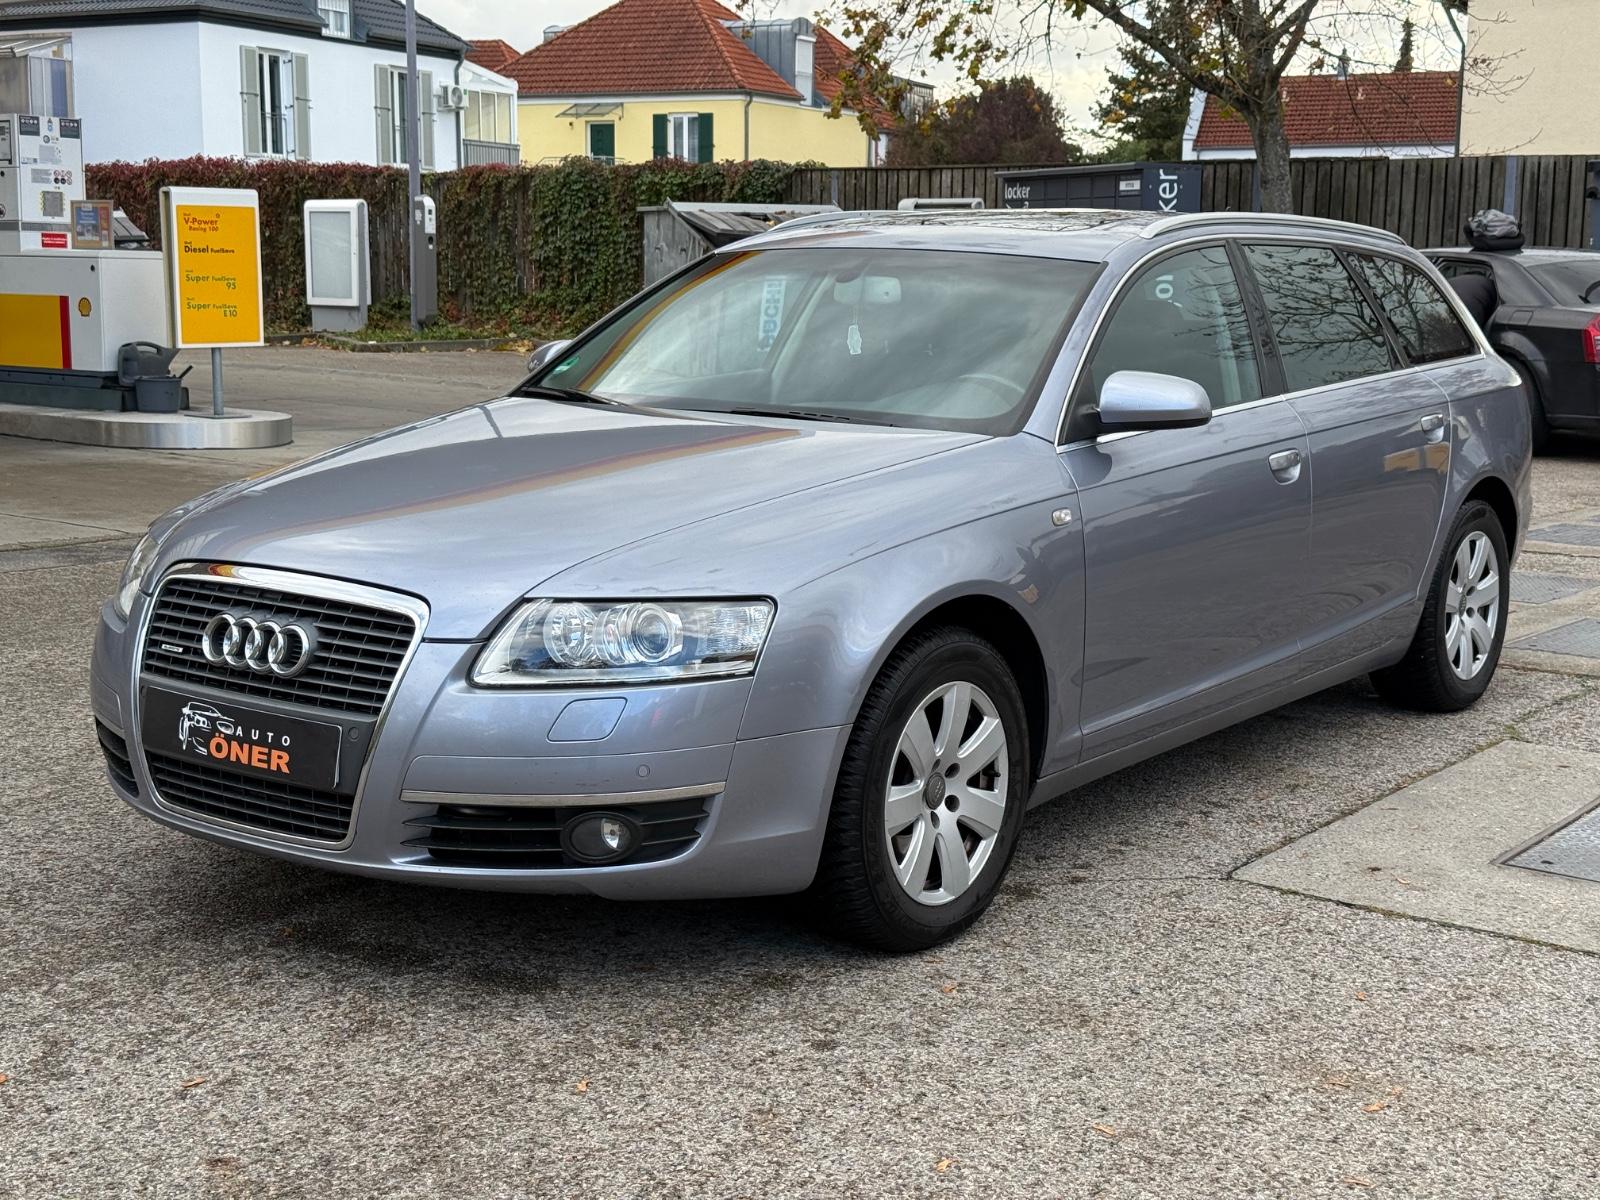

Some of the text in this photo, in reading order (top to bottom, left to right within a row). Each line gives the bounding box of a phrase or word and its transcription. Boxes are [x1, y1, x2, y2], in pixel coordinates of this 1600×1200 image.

[1004, 182, 1031, 199] locker
[184, 217, 218, 226] V-Power
[184, 245, 209, 253] Diesel
[185, 274, 209, 283] Super
[226, 282, 236, 290] 95
[186, 302, 211, 311] Super
[236, 726, 291, 746] AUTO
[209, 733, 291, 774] ÖNER
